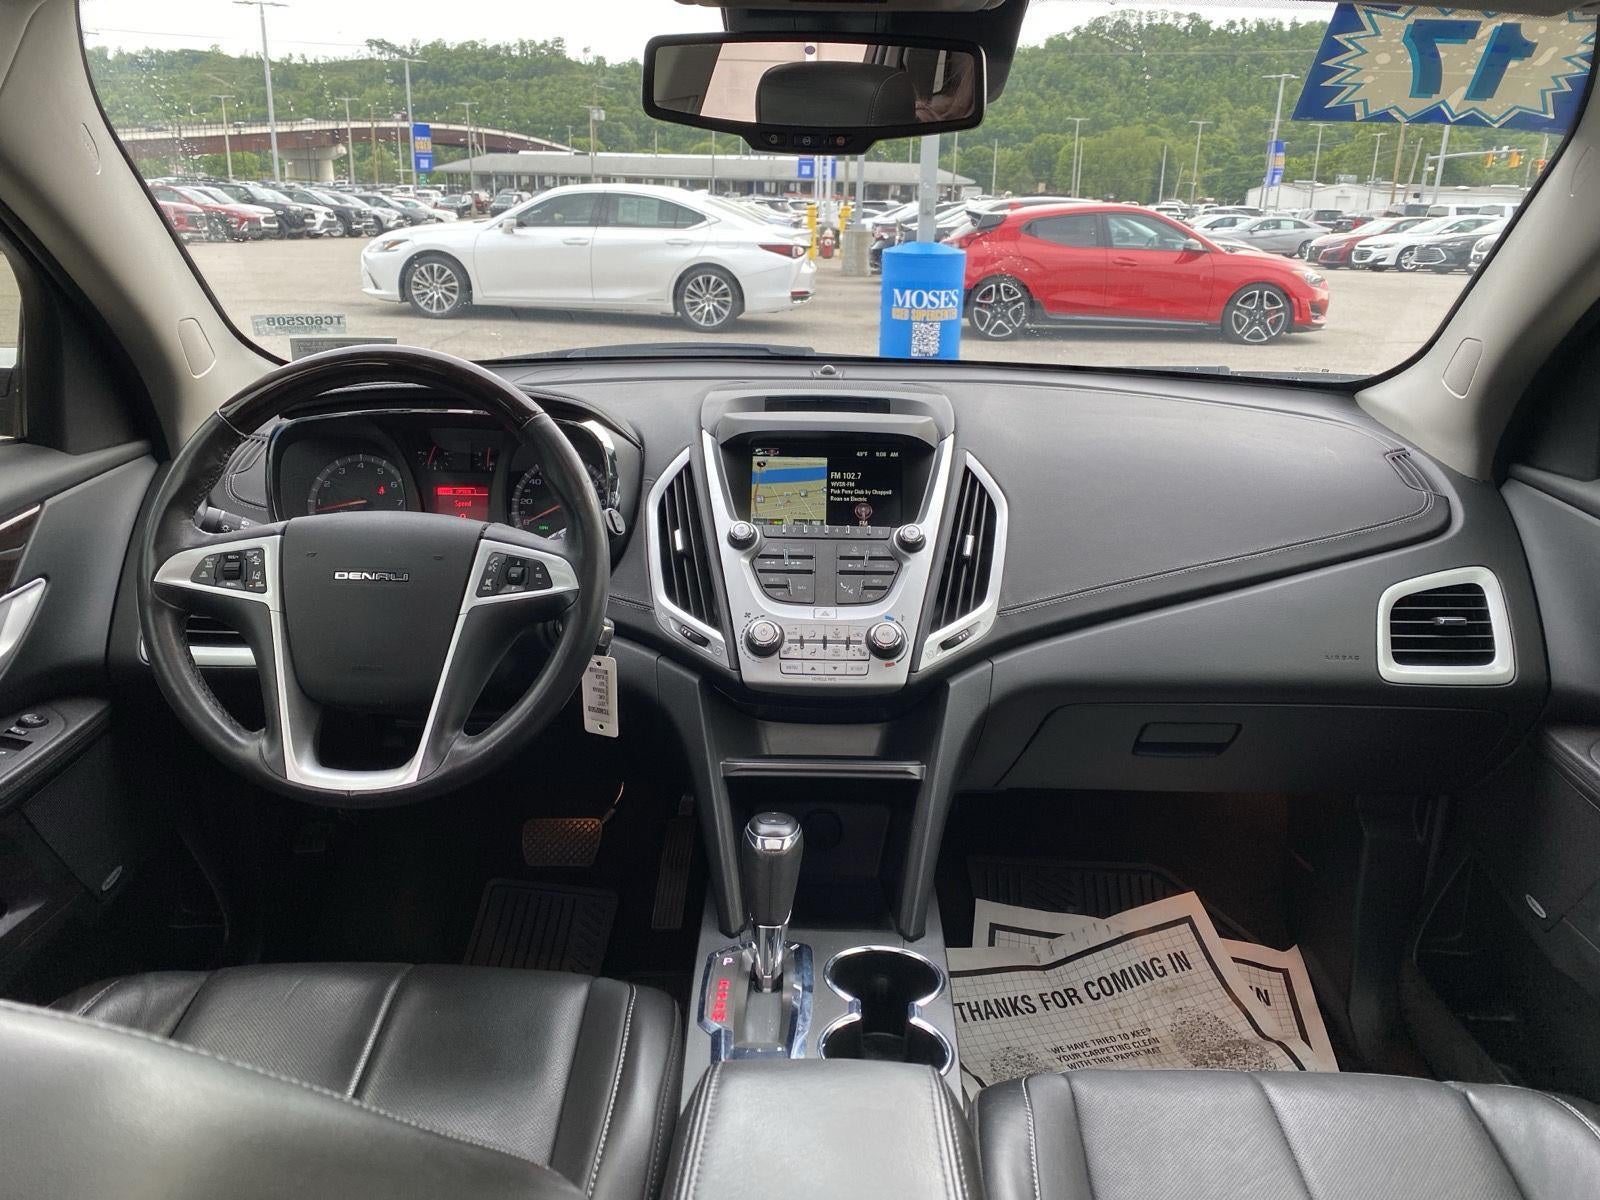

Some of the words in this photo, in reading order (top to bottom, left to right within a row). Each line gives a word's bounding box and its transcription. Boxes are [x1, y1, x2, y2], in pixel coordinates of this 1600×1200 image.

[892, 288, 959, 309] MOSES
[339, 467, 346, 475] 3
[377, 467, 384, 475] 5
[830, 471, 841, 480] FM
[842, 472, 862, 480] 102.7
[529, 478, 542, 486] 40
[333, 570, 409, 582] DENALI
[722, 957, 733, 966] P
[953, 994, 1037, 1023] THANKS
[1038, 987, 1084, 1011] FOR
[1084, 957, 1168, 1001] COMING
[1167, 950, 1192, 974] IN
[1050, 1046, 1065, 1055] WE
[1066, 1040, 1090, 1052] HAVE
[1090, 1035, 1117, 1046] TRIED
[1117, 1032, 1130, 1041] TO
[1130, 1027, 1151, 1039] KEEP
[1056, 1052, 1082, 1063] YOUR
[1082, 1043, 1132, 1059] CARPETING
[1131, 1036, 1160, 1049] CLEAN
[1066, 1058, 1093, 1070] WITH
[1093, 1055, 1114, 1065] THIS
[1114, 1049, 1143, 1061] PAPER
